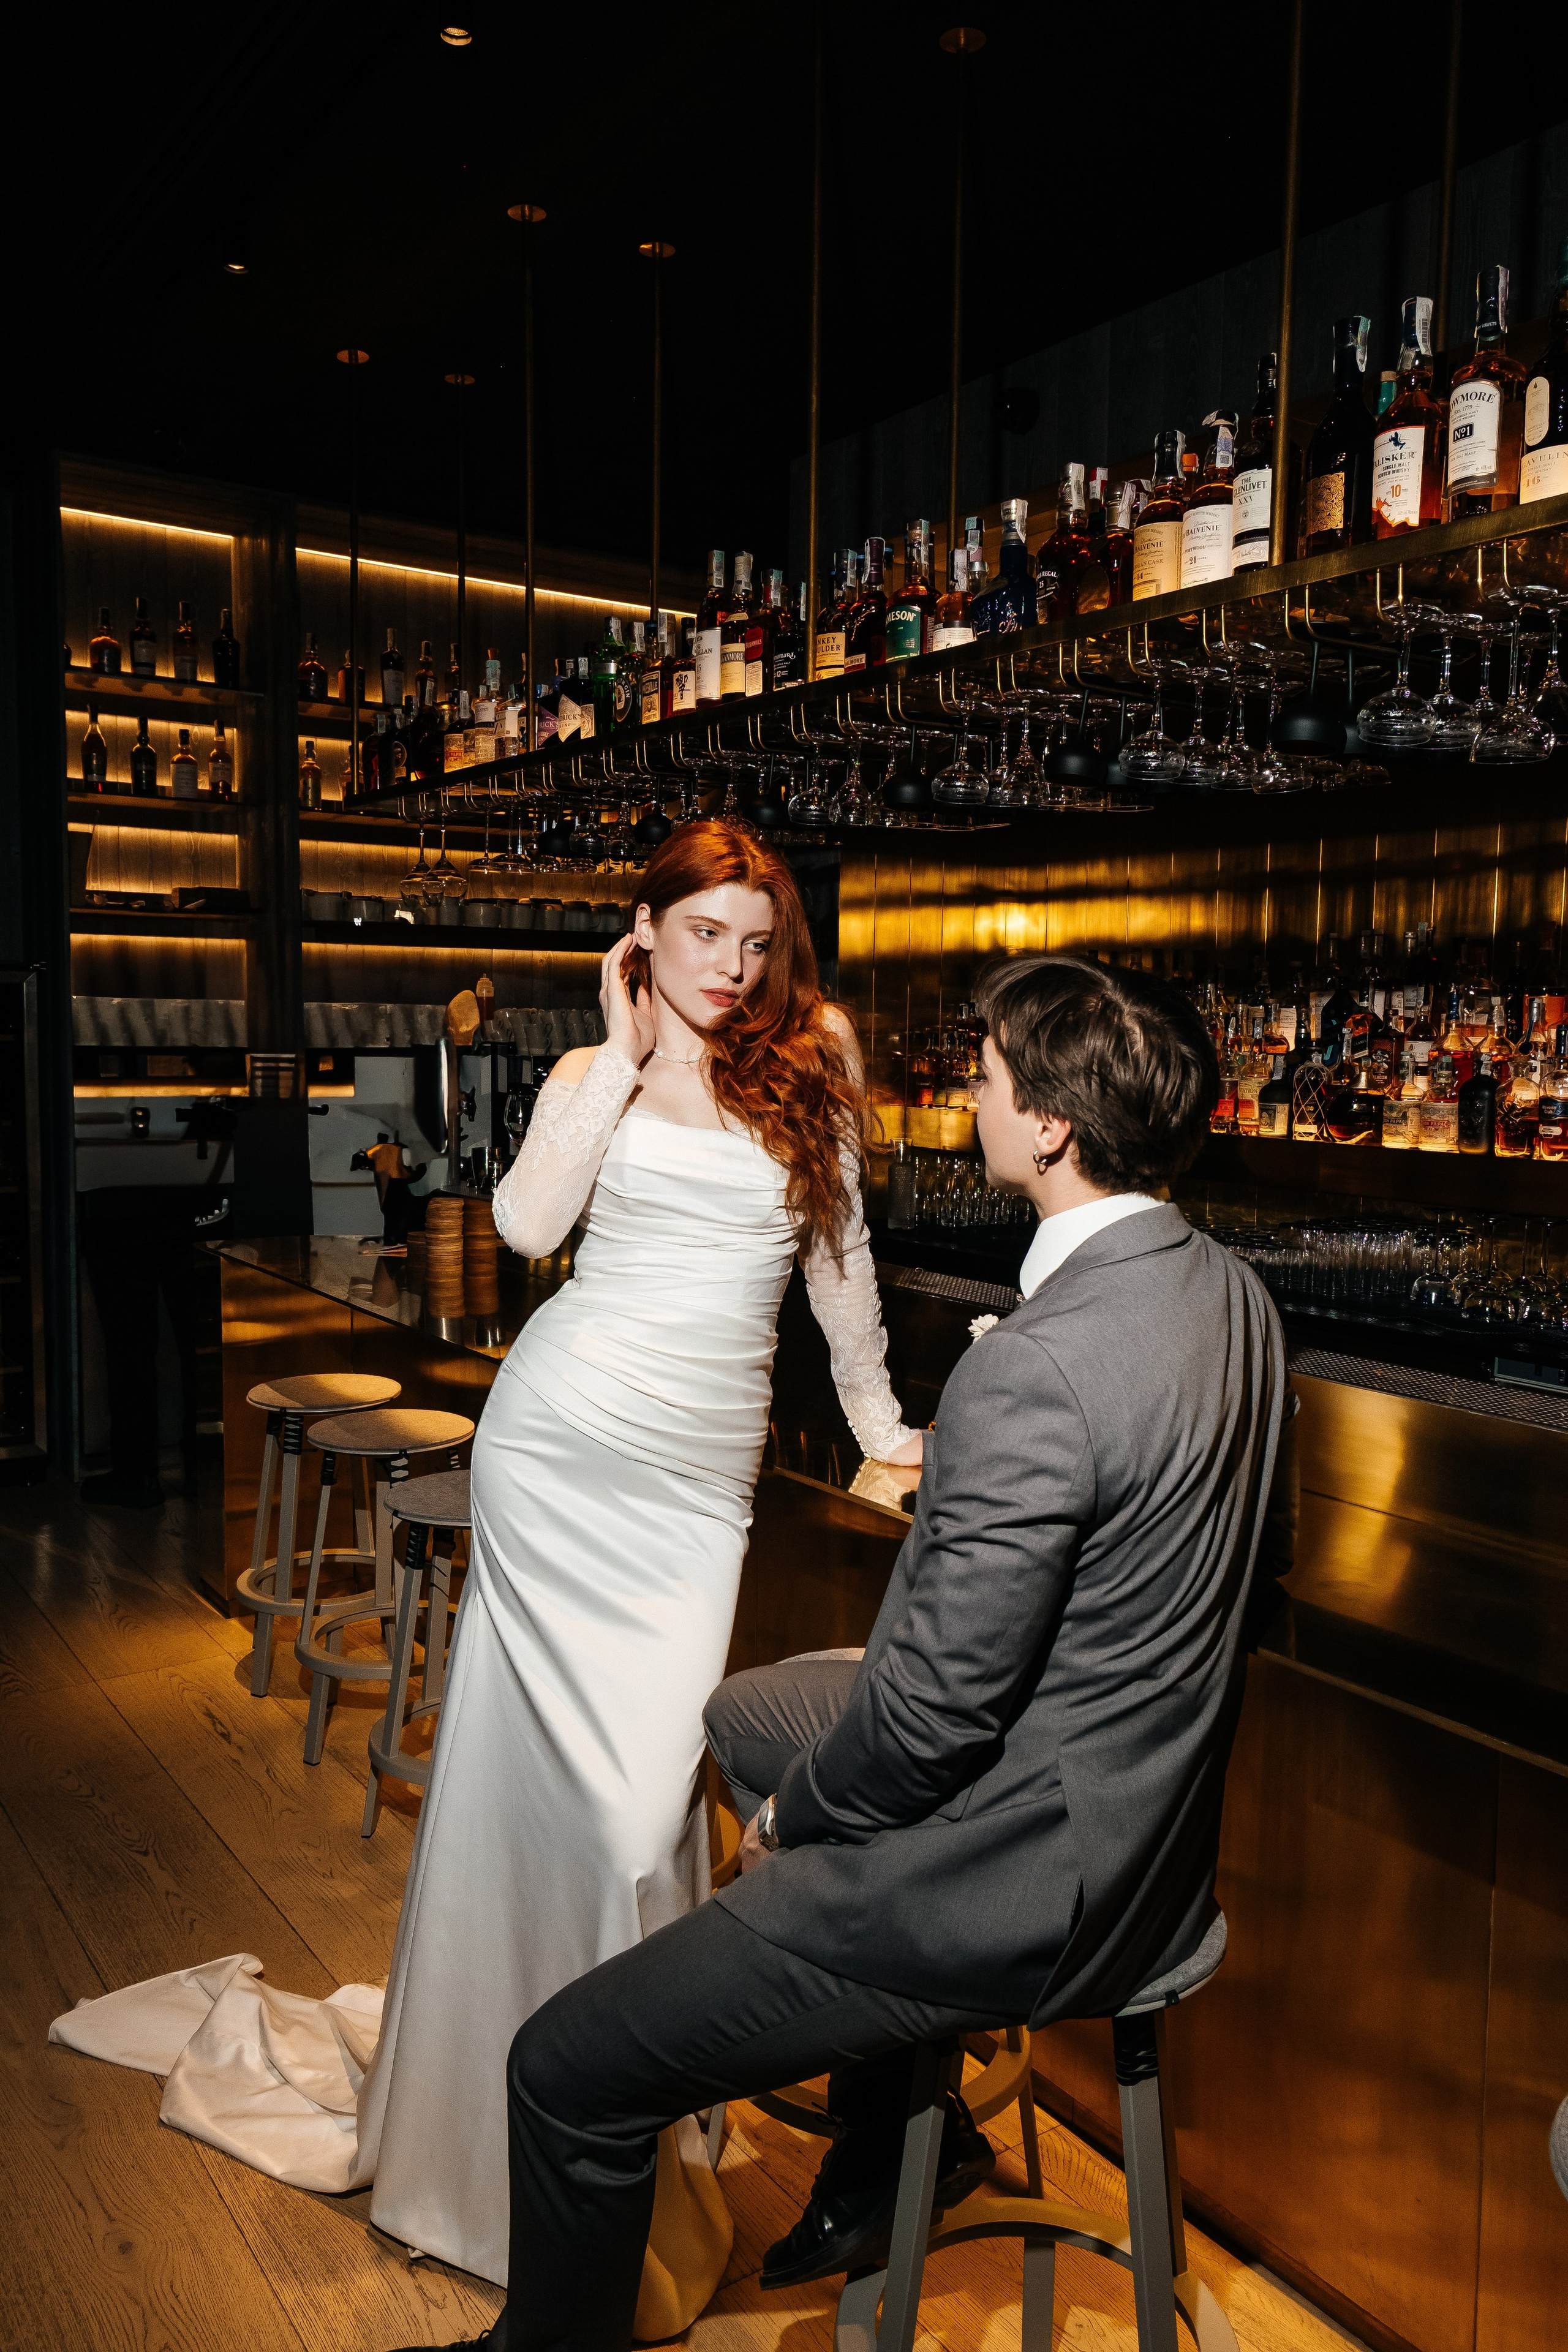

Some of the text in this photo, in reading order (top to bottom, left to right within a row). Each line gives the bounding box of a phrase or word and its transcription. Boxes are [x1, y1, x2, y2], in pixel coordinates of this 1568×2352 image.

[1378, 470, 1390, 479] SCOTCH
[1526, 475, 1540, 488] 16
[1390, 484, 1401, 498] 10
[1186, 525, 1220, 537] BALVENIE
[1189, 556, 1196, 565] 21
